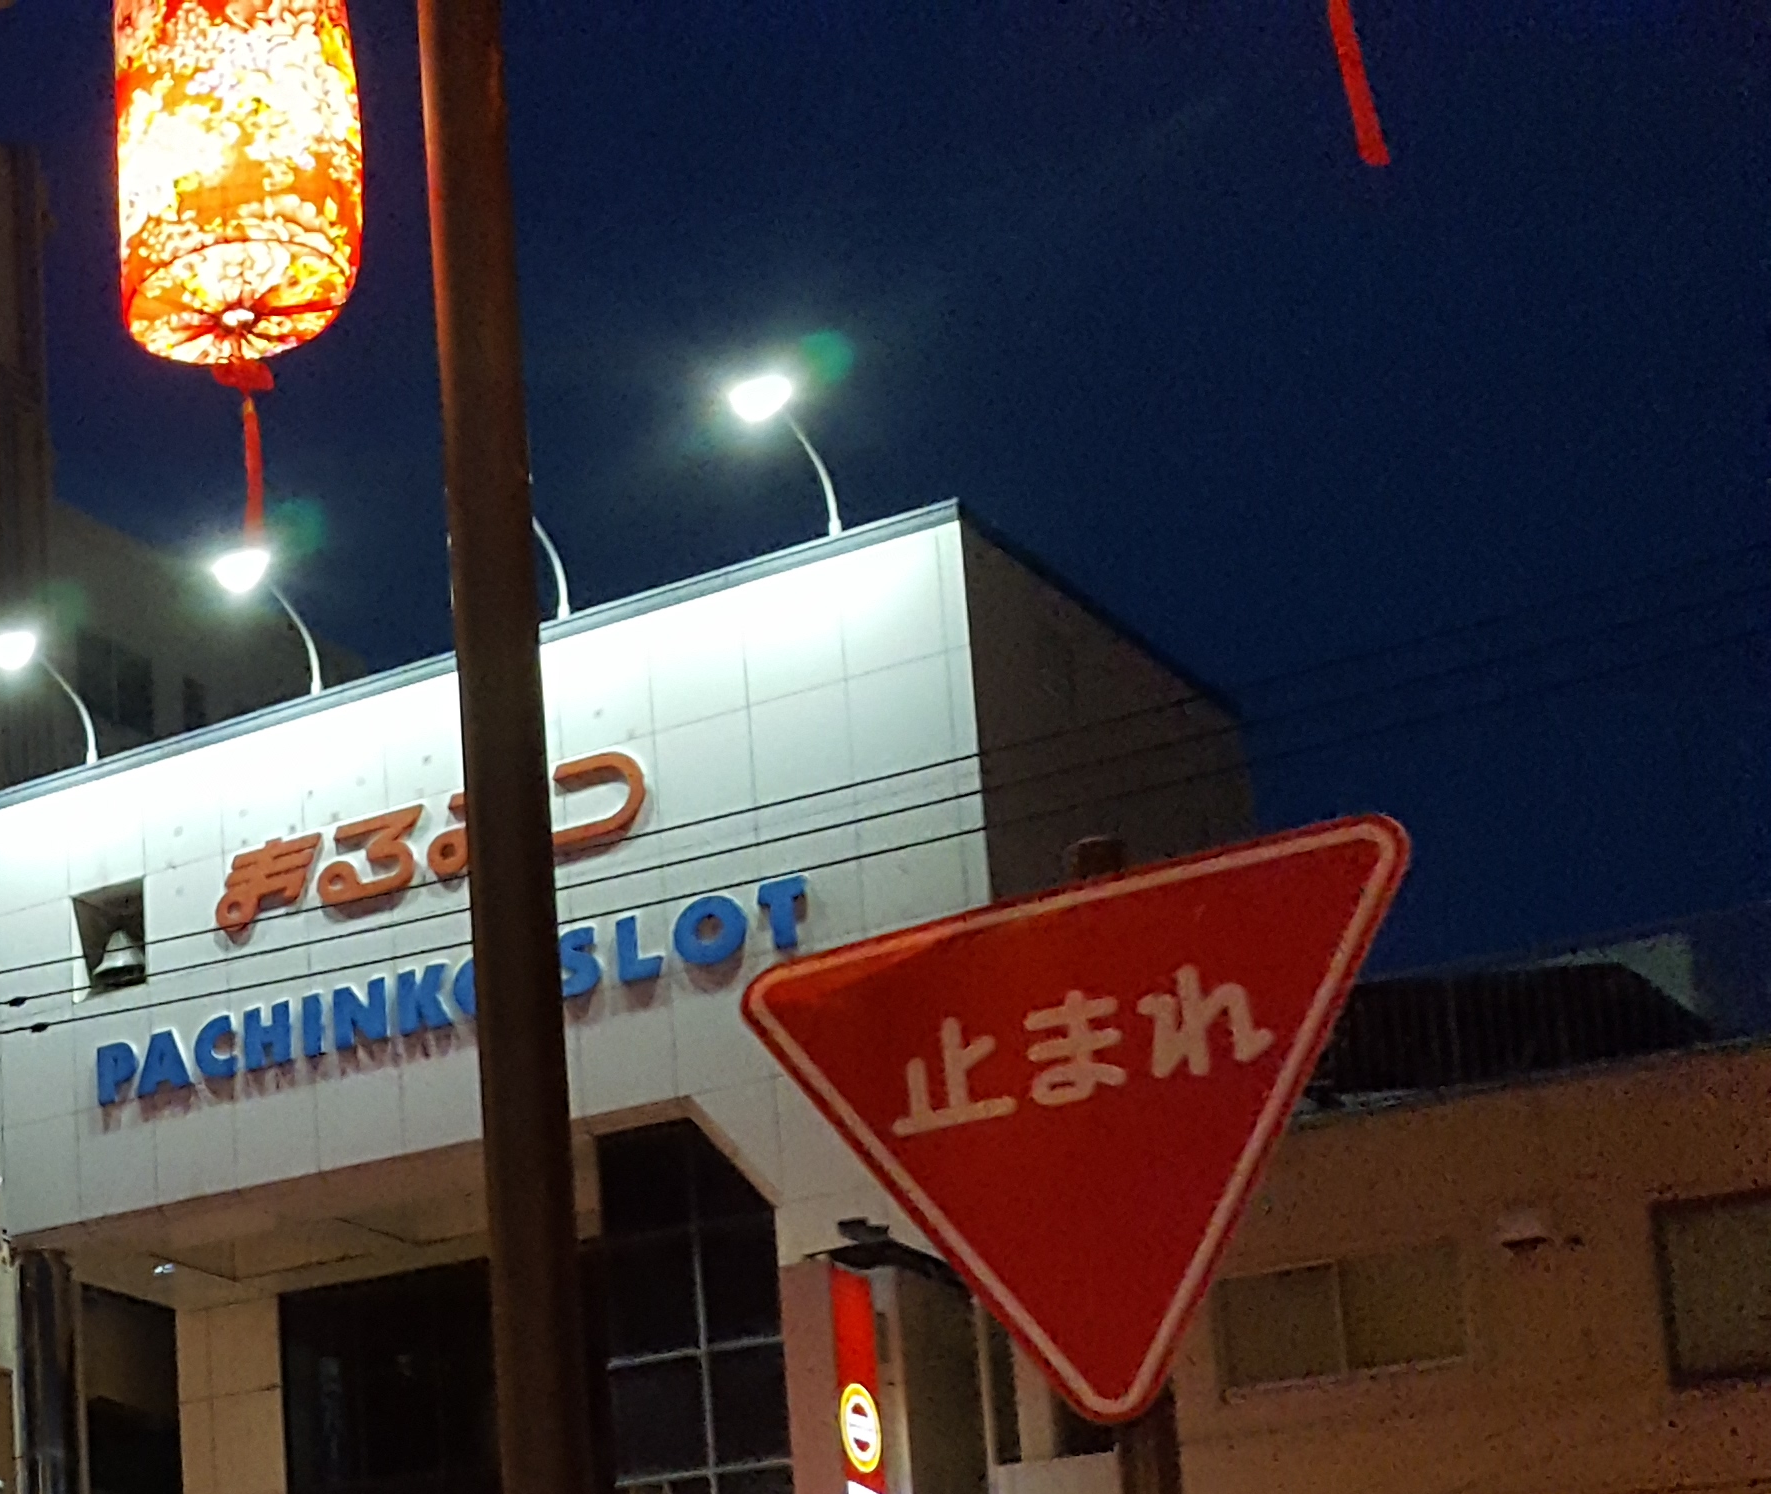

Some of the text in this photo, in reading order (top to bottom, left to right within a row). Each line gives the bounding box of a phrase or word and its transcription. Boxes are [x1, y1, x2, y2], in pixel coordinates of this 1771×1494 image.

[559, 875, 806, 996] SLOT
[893, 967, 1272, 1135] 止まれ
